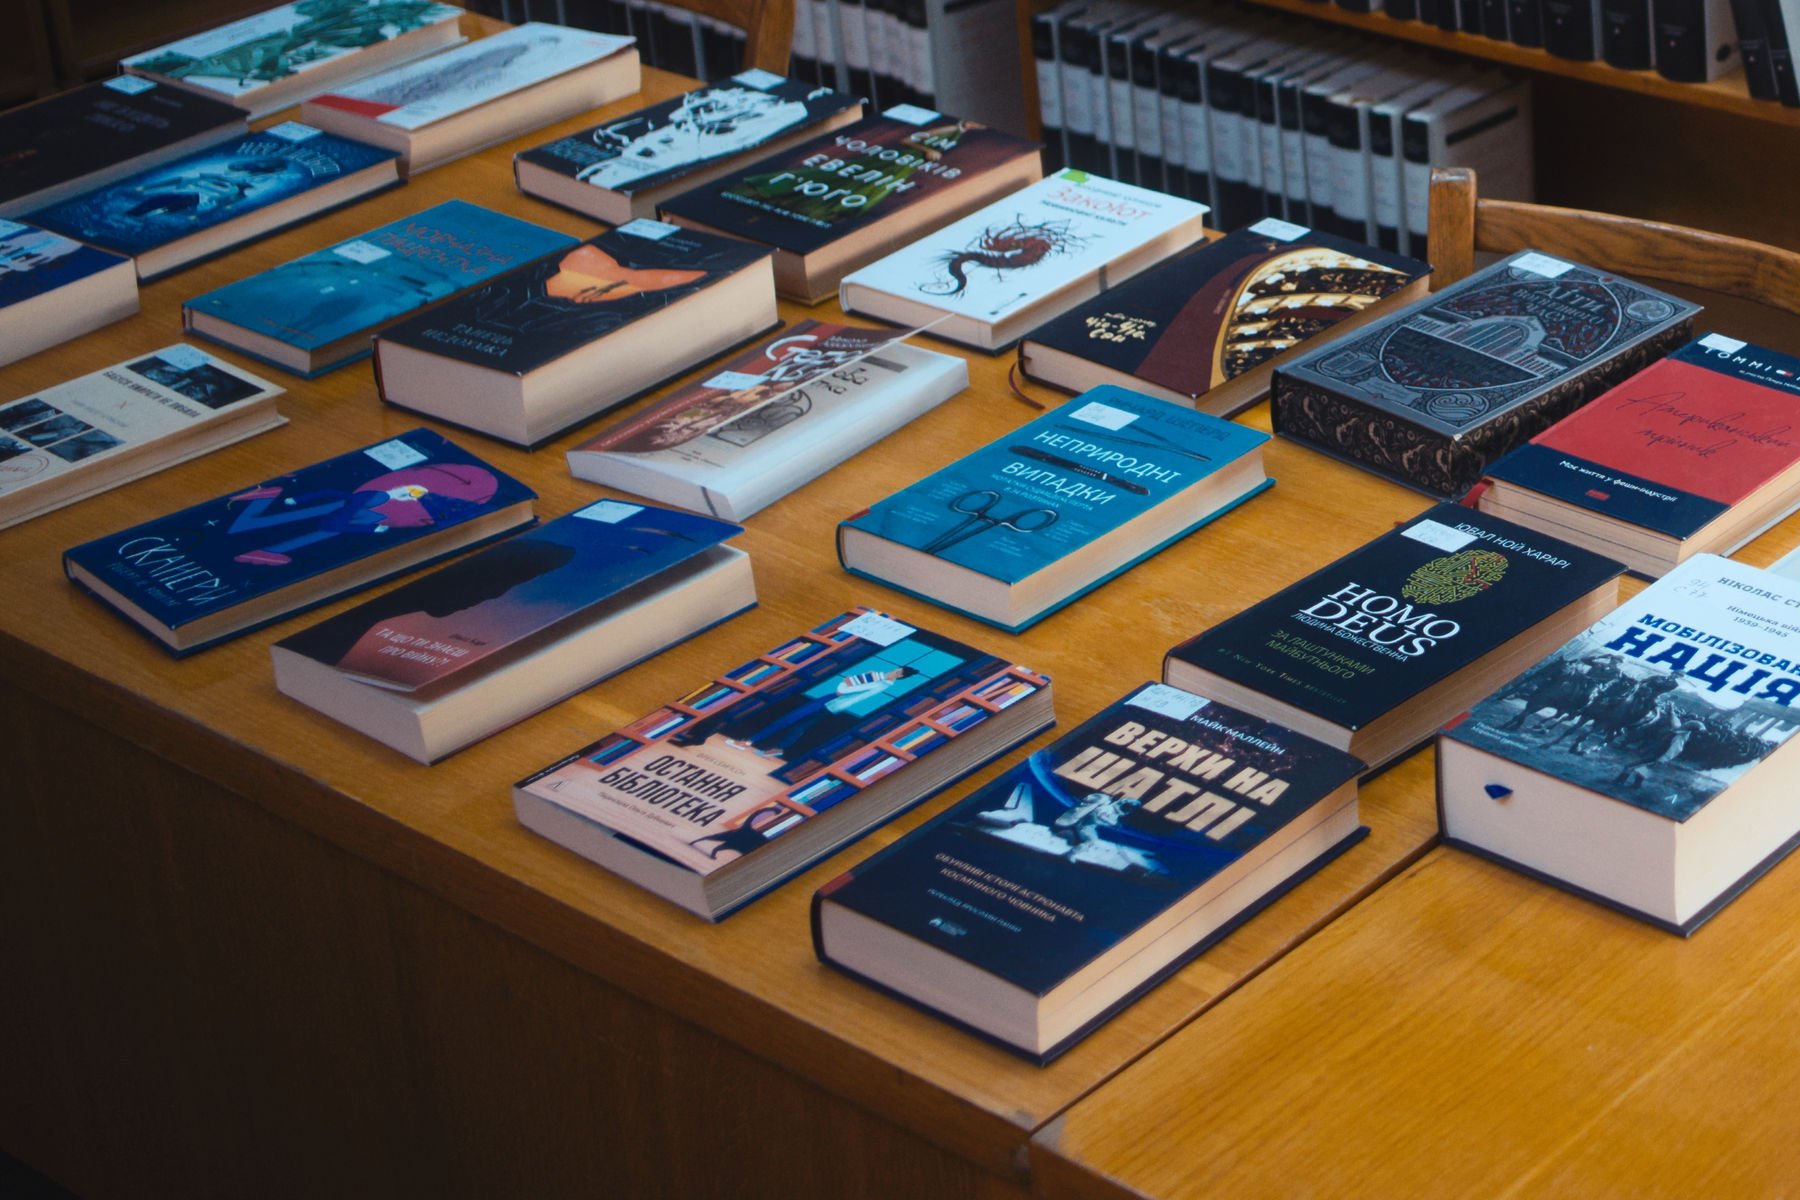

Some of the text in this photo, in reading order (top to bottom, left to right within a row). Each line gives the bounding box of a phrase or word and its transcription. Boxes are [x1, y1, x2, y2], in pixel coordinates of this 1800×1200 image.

[835, 136, 961, 179] ЧОЛОВІКІВ
[910, 131, 957, 150] СІМ
[802, 153, 915, 192] ЕВЕЛІН
[1033, 430, 1183, 485] НЕПРИРОДНІ
[1559, 460, 1577, 471] Моє
[1578, 465, 1604, 479] життя
[1000, 462, 1117, 506] ВИПАДКИ
[1455, 522, 1572, 570] ЮВАЛ НОЙ ХАРАРІ
[117, 534, 236, 608] СКАНЕРИ
[1716, 575, 1786, 604] НІКОЛАС
[1297, 598, 1437, 657] DEUS
[1326, 582, 1461, 640] HOMO
[1725, 604, 1781, 628] Німецька
[376, 627, 391, 641] ТА
[390, 630, 415, 648] ЩО
[379, 644, 402, 659] ПРО
[1266, 639, 1355, 680] МАЙБУТНЬОГО
[1270, 629, 1376, 675] ЗА ЛАШТУНКАМИ
[1290, 612, 1410, 662] ЛЮДИНА БОЖЕСТВЕННА
[1190, 714, 1287, 756] МАЙК МАЛЛЕЙН
[644, 754, 747, 804] ОСТАННЯ
[1102, 720, 1292, 807] ВЕРХИ НА
[598, 766, 727, 828] БІБЛІОТЕКА
[1052, 745, 1257, 842] ШАТЛІ
[938, 865, 1057, 923] КОСМІЧНОГО ЧОВНИКА
[1018, 886, 1086, 924] АСТРОНАВТА
